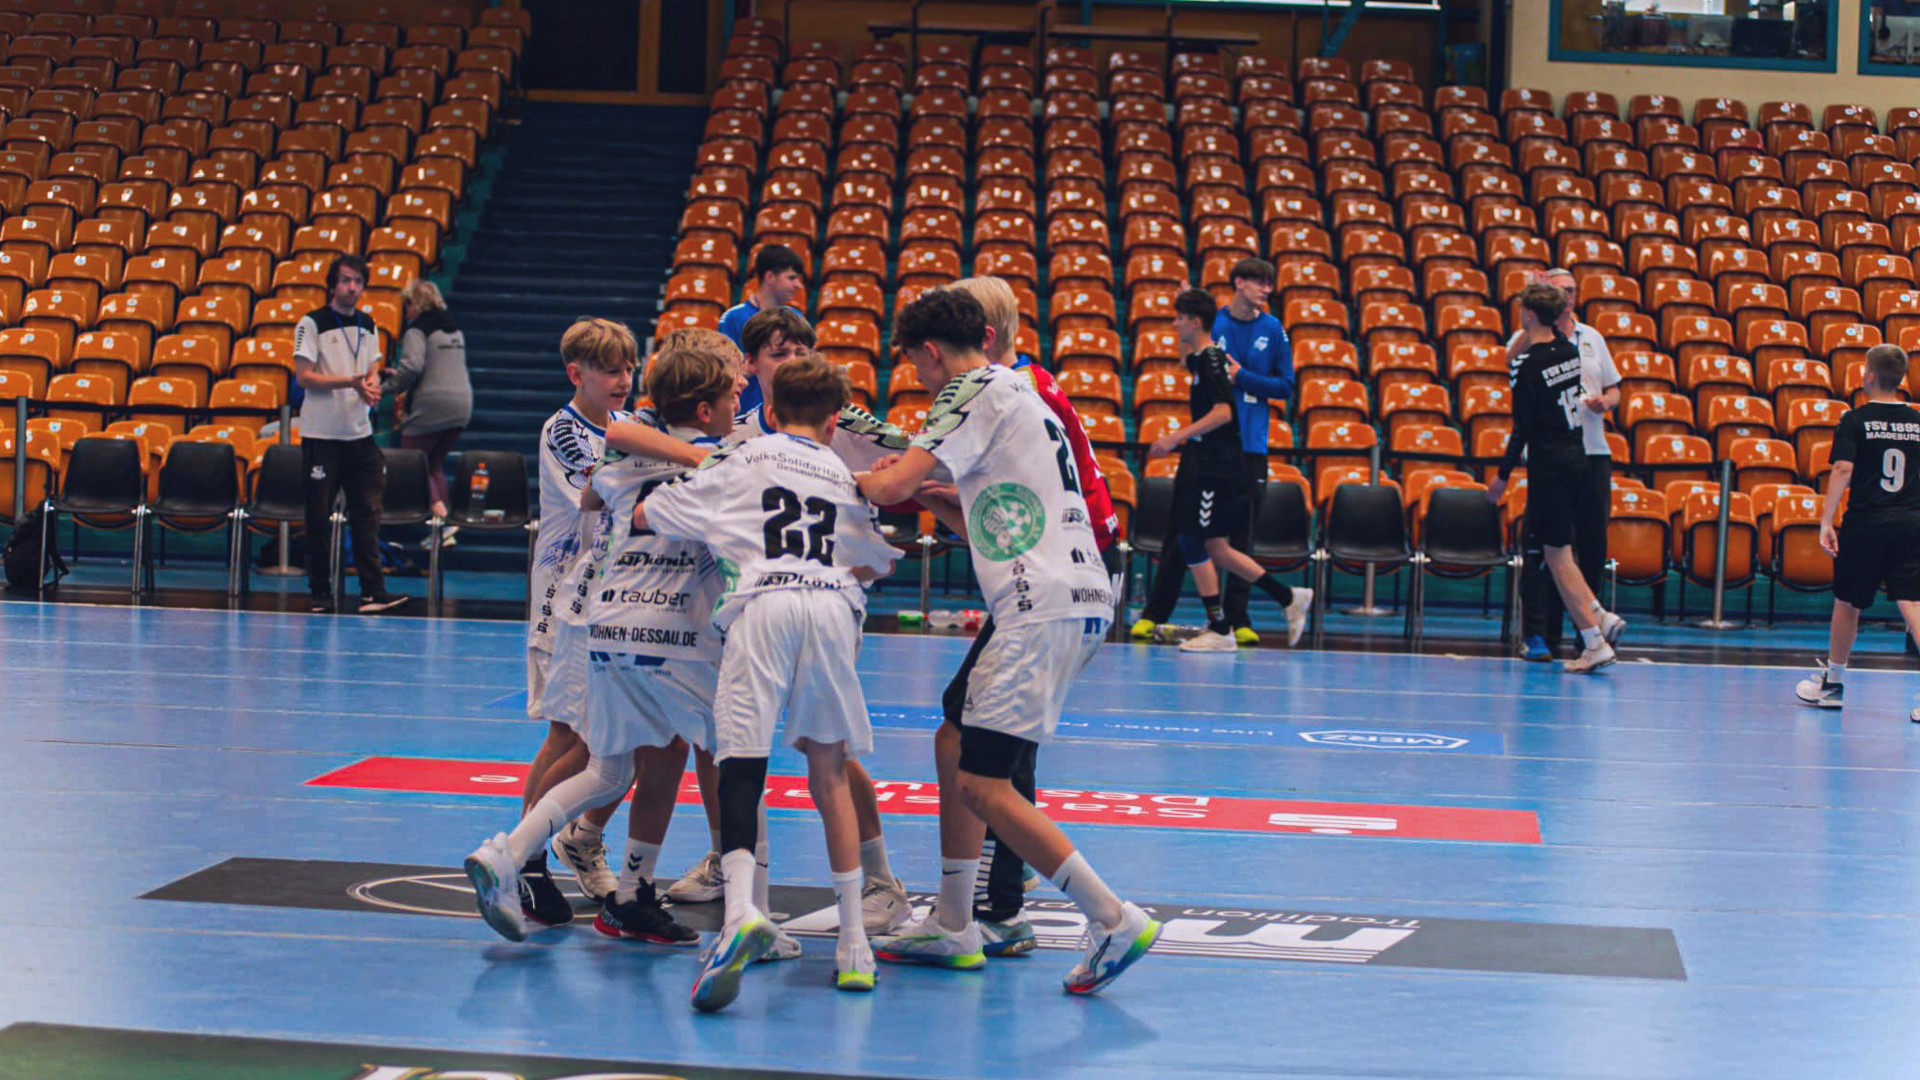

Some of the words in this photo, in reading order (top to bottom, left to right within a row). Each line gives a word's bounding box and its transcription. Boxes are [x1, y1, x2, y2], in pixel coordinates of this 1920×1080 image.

[1864, 421, 1888, 431] FSV
[1880, 448, 1906, 492] 9
[761, 486, 837, 567] 22
[620, 588, 691, 607] tauber
[1321, 733, 1446, 746] MERZ
[1180, 907, 1422, 929] Tradition
